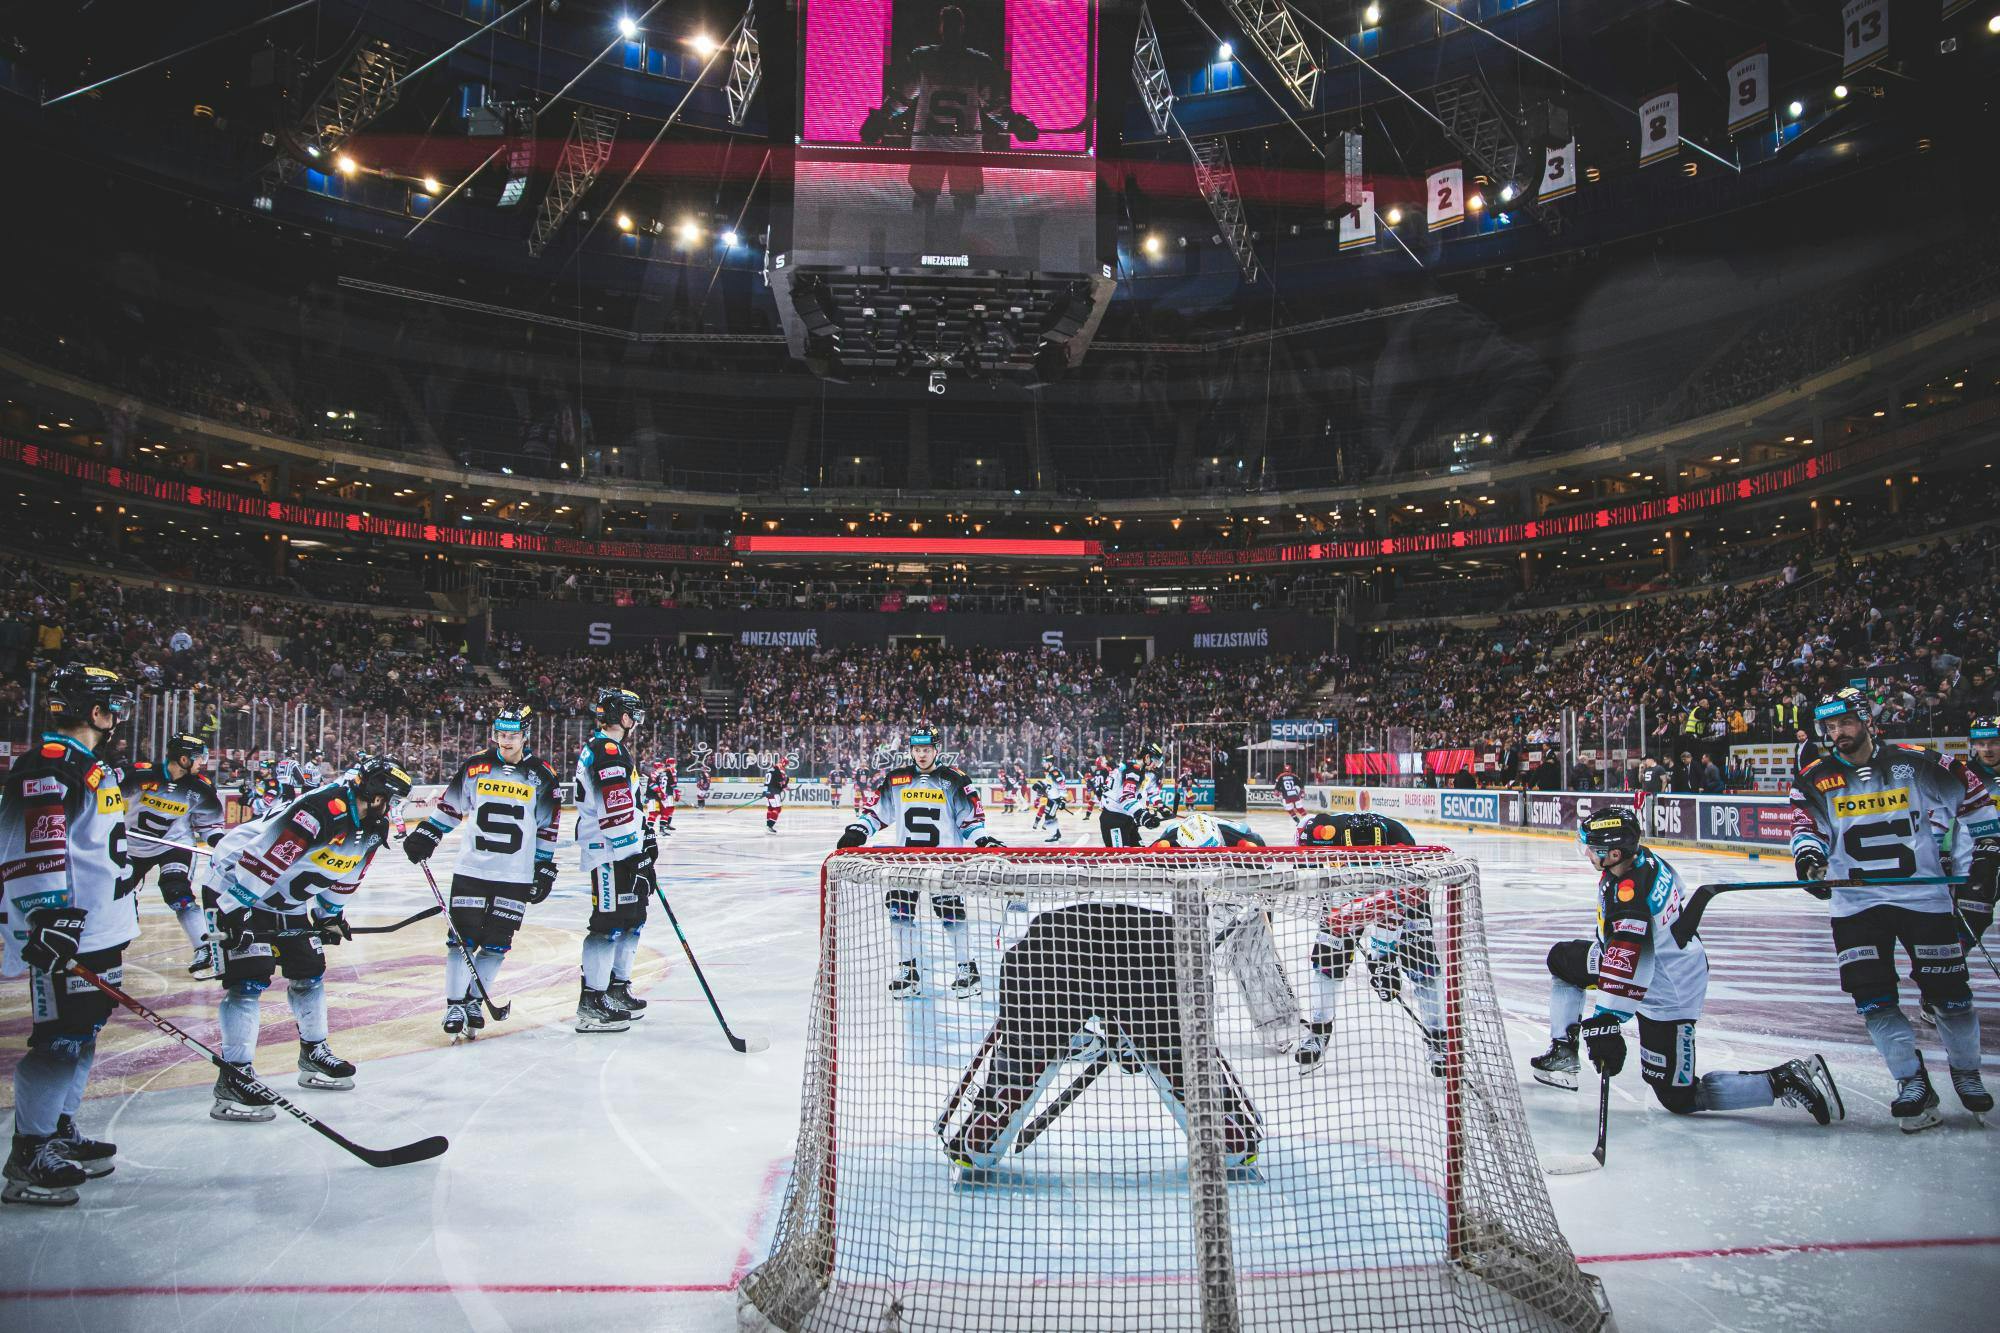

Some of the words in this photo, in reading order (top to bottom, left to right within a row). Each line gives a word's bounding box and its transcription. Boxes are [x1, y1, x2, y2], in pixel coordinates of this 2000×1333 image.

[1846, 10, 1881, 48] 13
[1738, 78, 1757, 105] 9
[1649, 116, 1667, 141] 8
[1548, 157, 1565, 180] 3
[1438, 187, 1452, 210] 2
[921, 254, 968, 267] #NEZASTAVÍŠ
[1677, 482, 1741, 511] SHOWTIME
[279, 504, 351, 531] SHOWTIME
[1607, 497, 1670, 525] SHOWTIME
[358, 515, 429, 540] SHOWTIME
[1463, 523, 1527, 547] SHOWTIME
[1535, 511, 1600, 538] SHOWTIME
[435, 526, 504, 548] SHOWTIME
[1320, 538, 1385, 559] SHOWTIME
[1391, 532, 1455, 553] SHOWTIME
[588, 622, 612, 646] S
[741, 628, 817, 647] #NEZASTAVÍŠ
[1193, 628, 1268, 648] #NEZASTAVÍŠ
[1818, 704, 1845, 715] Tipsport
[1283, 780, 1295, 791] 61
[1644, 771, 1652, 781] S
[478, 782, 529, 798] FORTUNA
[1331, 795, 1355, 806] FORTUNA
[1372, 796, 1400, 807] mastercard
[142, 796, 186, 813] FORTUNA
[1444, 796, 1494, 820] SENCOR
[1838, 793, 1908, 812] FORTUNA
[475, 801, 525, 855] S
[904, 807, 940, 847] S
[1591, 820, 1620, 830] FORTUNA
[1711, 806, 1754, 839] PRE
[1909, 811, 1920, 833] C
[1843, 818, 1917, 878] S
[602, 872, 610, 910] DAIKIN
[1918, 948, 1938, 956] STAGES
[1921, 963, 1965, 974] BAUER
[1683, 1025, 1693, 1072] DAIKIN
